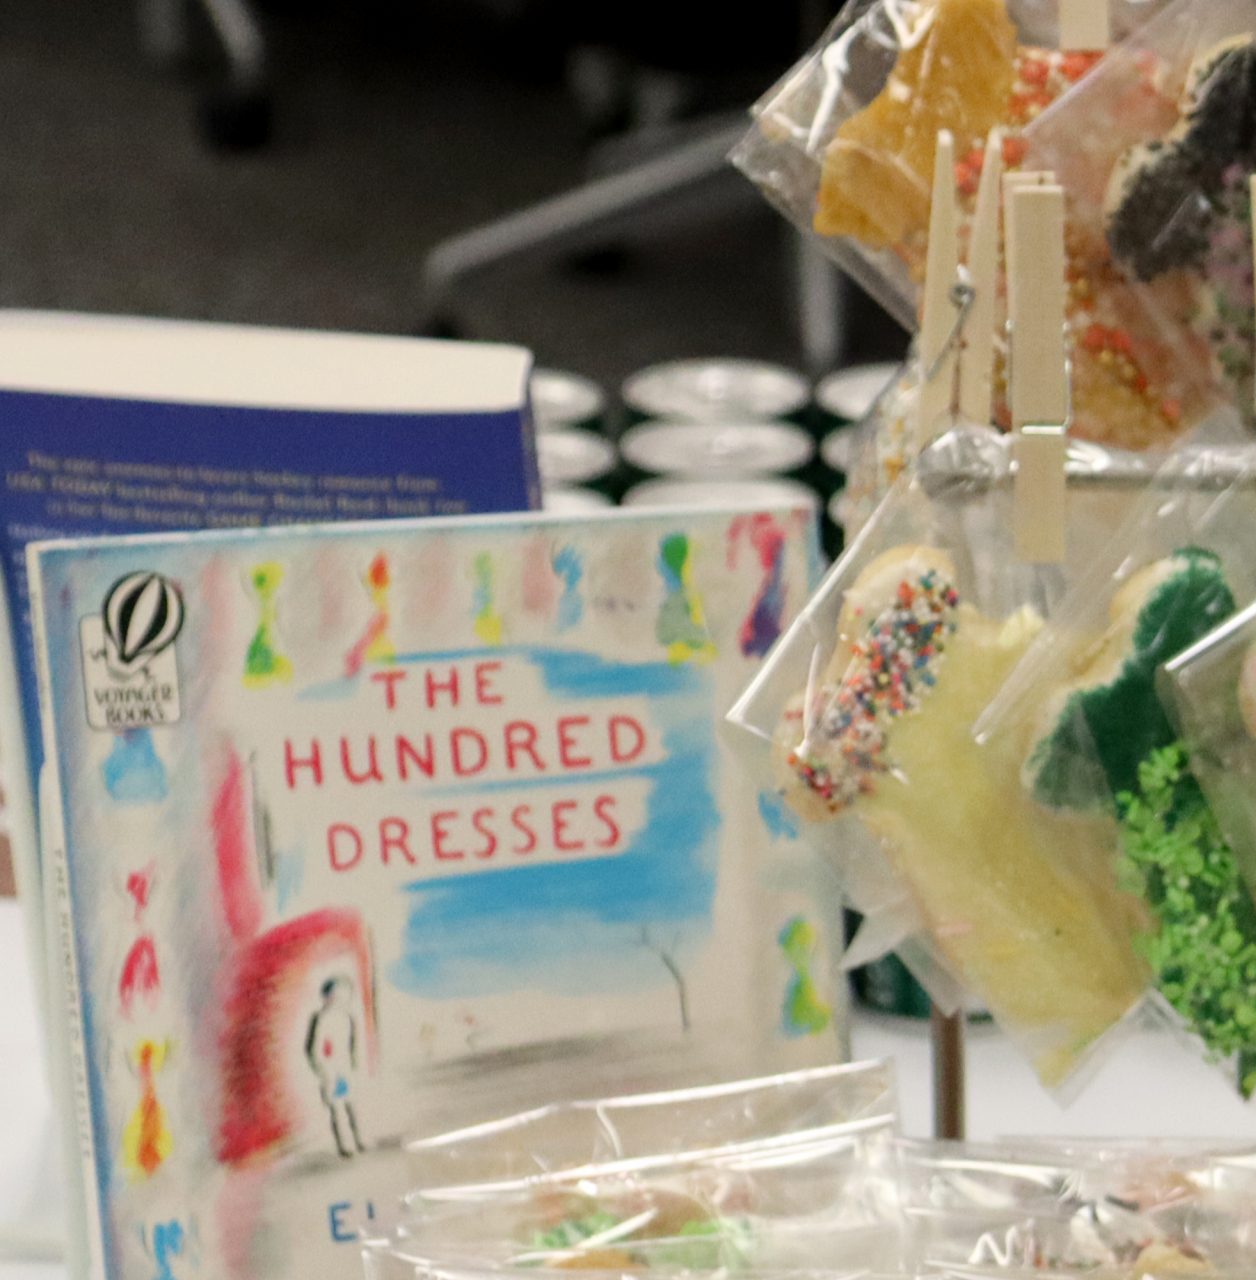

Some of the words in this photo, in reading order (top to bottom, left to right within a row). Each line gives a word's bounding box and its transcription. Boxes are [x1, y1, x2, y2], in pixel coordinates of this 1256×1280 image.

[94, 684, 172, 706] VOYAGER
[373, 663, 503, 709] THE
[106, 704, 166, 726] BOOKS
[285, 716, 646, 788] HUNDRED
[328, 796, 621, 872] DRESSES
